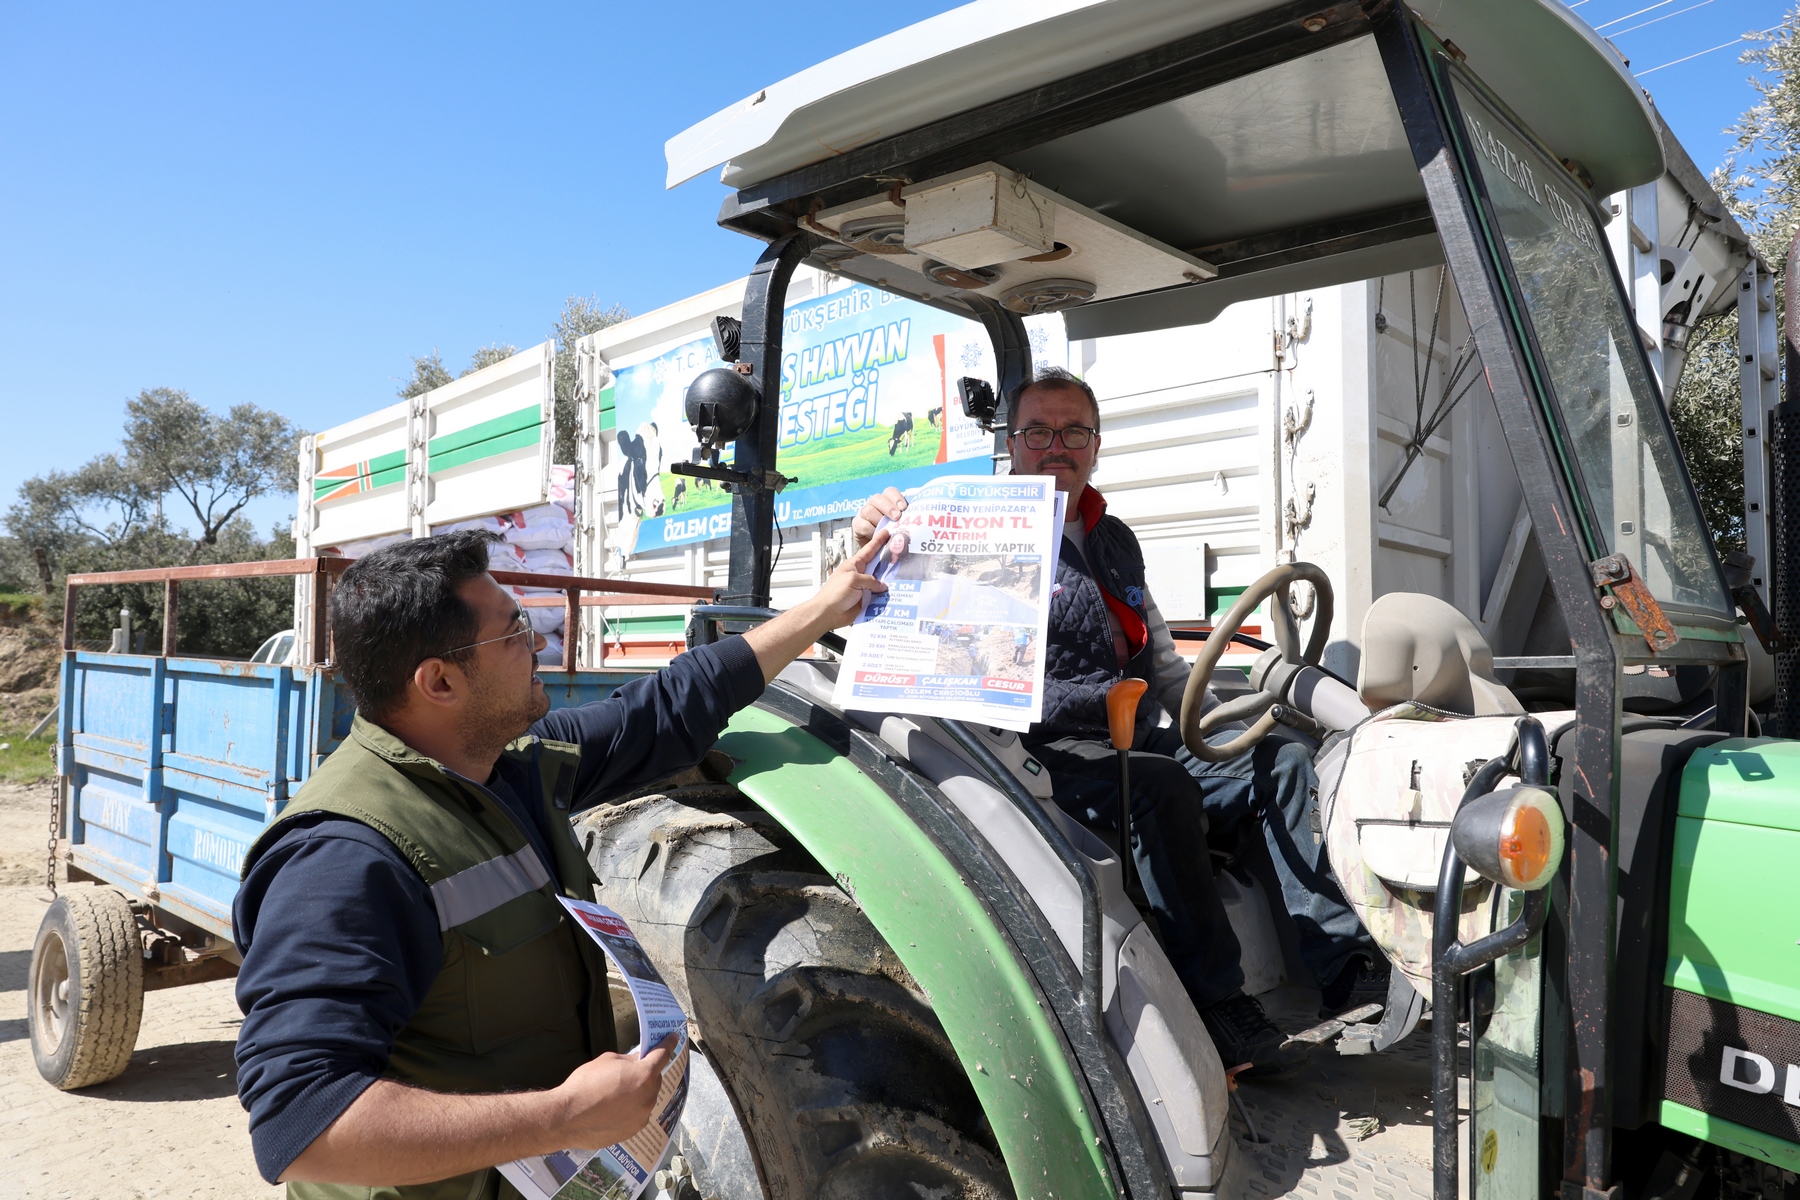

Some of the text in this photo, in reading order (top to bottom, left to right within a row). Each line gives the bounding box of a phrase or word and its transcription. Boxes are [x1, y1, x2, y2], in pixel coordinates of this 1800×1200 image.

[799, 317, 911, 389] HAYVAN
[778, 368, 879, 449] ESTEĞİ
[959, 484, 1039, 500] BÜYÜKŞEHİR
[972, 503, 1036, 513] YENİPAZAR'A
[663, 516, 708, 542] ÖZLEM
[804, 506, 826, 518] AYDIN
[928, 511, 1006, 529] MİLYON
[1009, 516, 1033, 529] TL
[932, 530, 987, 541] YATIRIM
[920, 540, 1035, 554] SÖZ VERDİK, YAPTIK
[893, 609, 910, 618] KM
[863, 673, 1026, 691] DÜRÜST ÇALIŞKAN CESUR
[933, 689, 981, 697] ÇERÇİOĞLU
[617, 1153, 640, 1177] BÜYÜYOR
